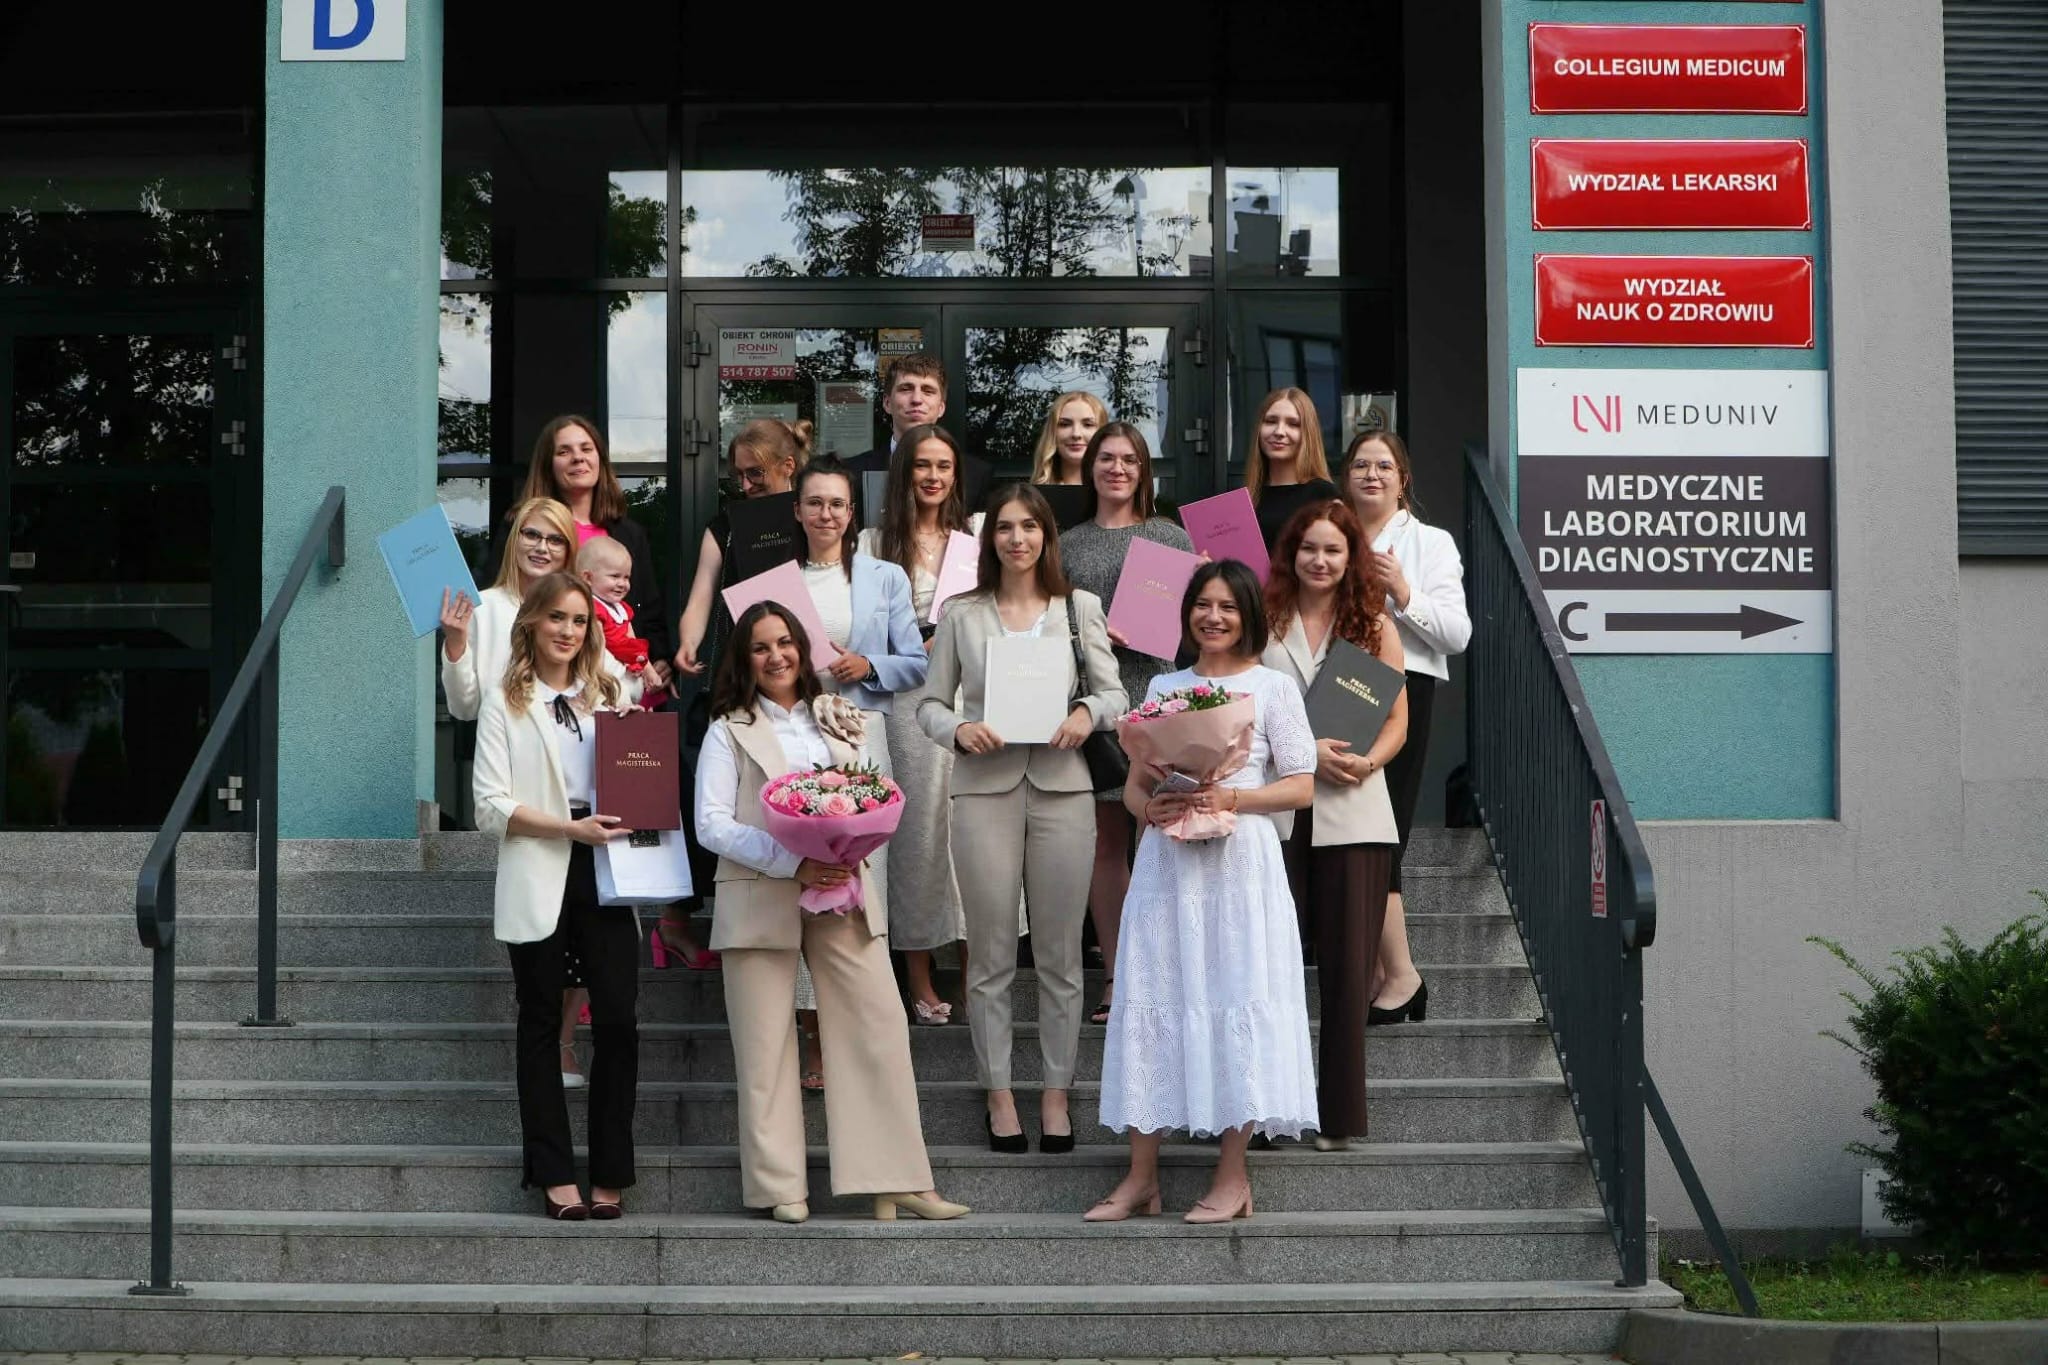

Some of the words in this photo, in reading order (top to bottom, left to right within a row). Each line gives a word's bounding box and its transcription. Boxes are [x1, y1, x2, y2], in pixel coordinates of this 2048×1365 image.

[313, 0, 375, 50] D
[1554, 58, 1680, 76] COLLEGIUM
[1686, 59, 1786, 77] MEDICUM
[1569, 174, 1665, 192] WYDZIAŁ
[1671, 174, 1778, 192] LEKARSKI
[1624, 278, 1726, 297] WYDZIAŁ
[1576, 303, 1640, 321] NAUK
[1647, 303, 1663, 321] O
[1669, 303, 1774, 322] ZDROWIU
[722, 331, 754, 340] OBIEKT
[760, 331, 794, 340] CHRONI
[737, 343, 778, 352] RONIN
[880, 342, 917, 351] OBIEKT
[722, 367, 744, 377] 514
[747, 367, 769, 377] 787
[771, 367, 794, 377] 507
[1637, 405, 1778, 425] MEDUNIV
[1586, 475, 1764, 501] MEDYCZNE
[1543, 511, 1807, 537] LABORATORIUM
[1538, 547, 1814, 573] DIAGNOSTYCZNE
[1558, 601, 1589, 641] C
[1350, 678, 1371, 694] PRACA
[616, 760, 661, 768] MAGISTERSKA
[627, 752, 650, 760] PRACA
